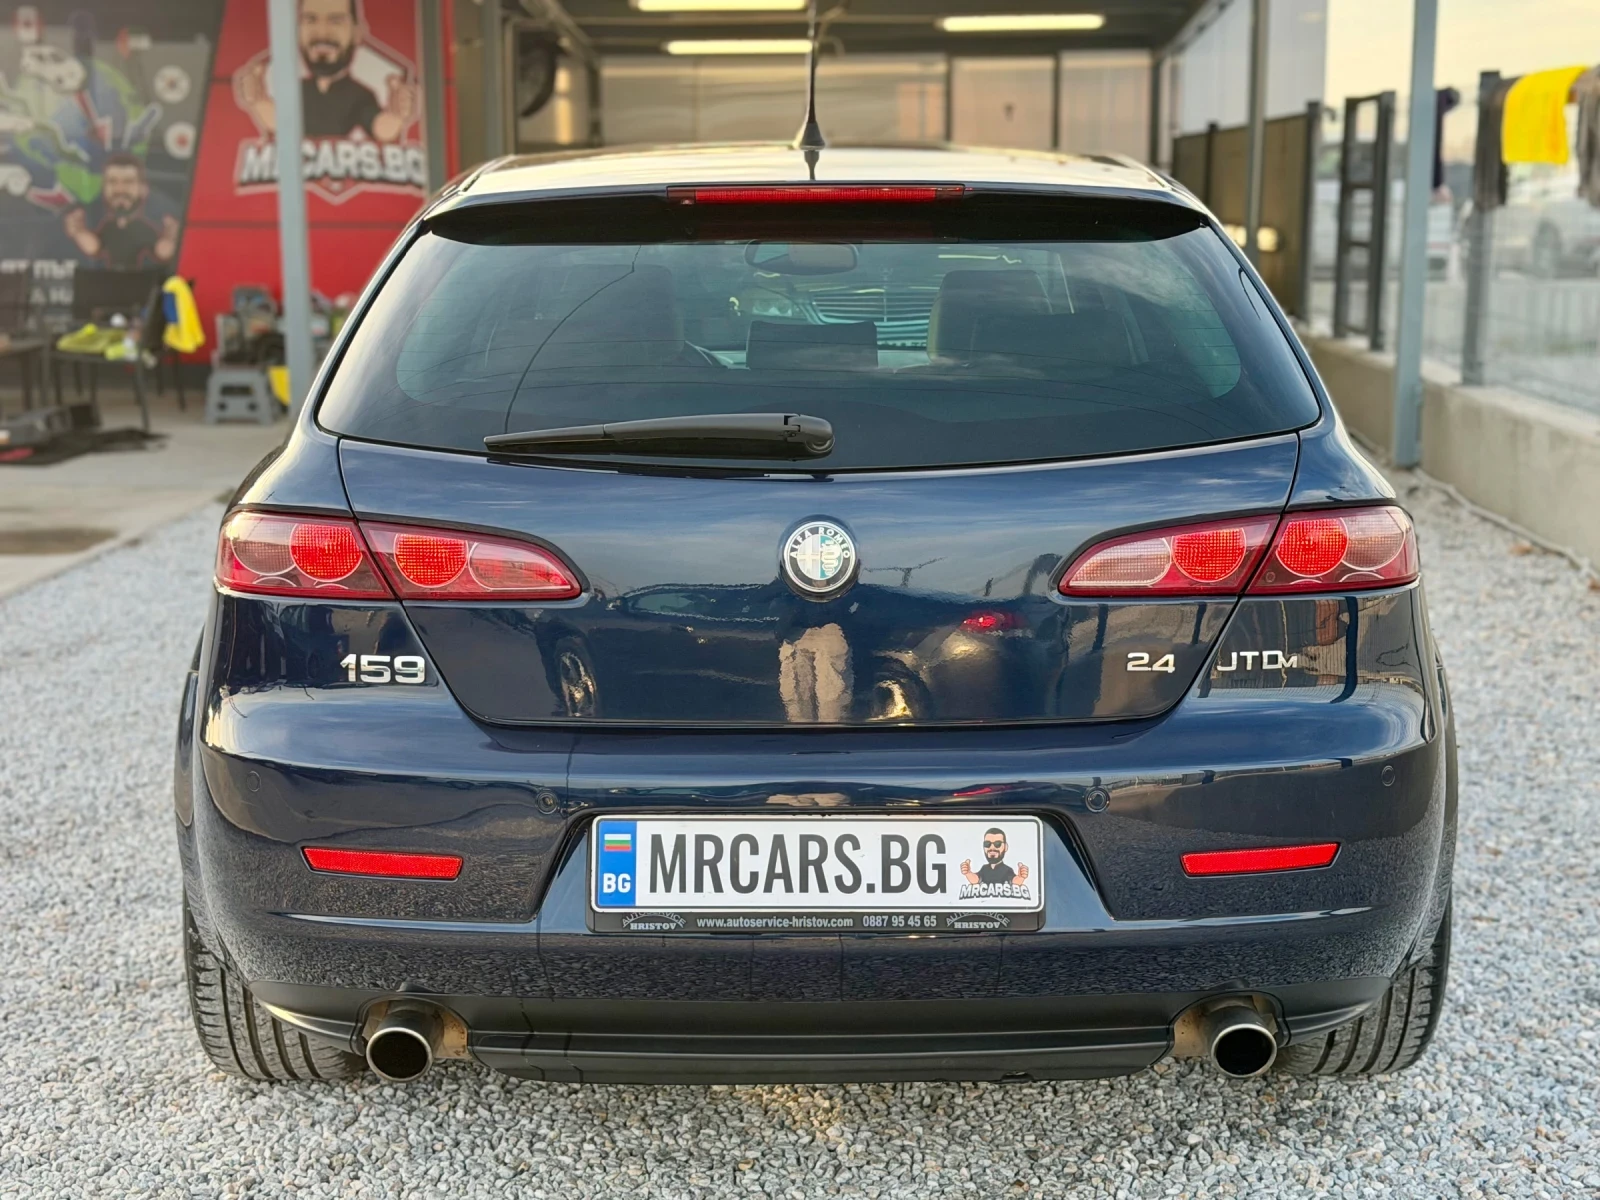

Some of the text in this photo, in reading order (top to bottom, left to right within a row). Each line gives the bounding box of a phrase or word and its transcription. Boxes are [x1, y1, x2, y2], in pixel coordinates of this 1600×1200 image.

[240, 139, 426, 187] MCARS.BG
[789, 527, 851, 559] ALFA ROMEO
[340, 653, 425, 684] 159
[649, 833, 947, 895] MRCARS.BG
[602, 872, 631, 894] BG
[959, 882, 1031, 901] MRCARS.BG
[629, 922, 677, 931] HRISTOV
[696, 915, 937, 928] www.autoservice-hristov.com 0887 95 45 65
[953, 921, 1001, 929] HRISTOV
